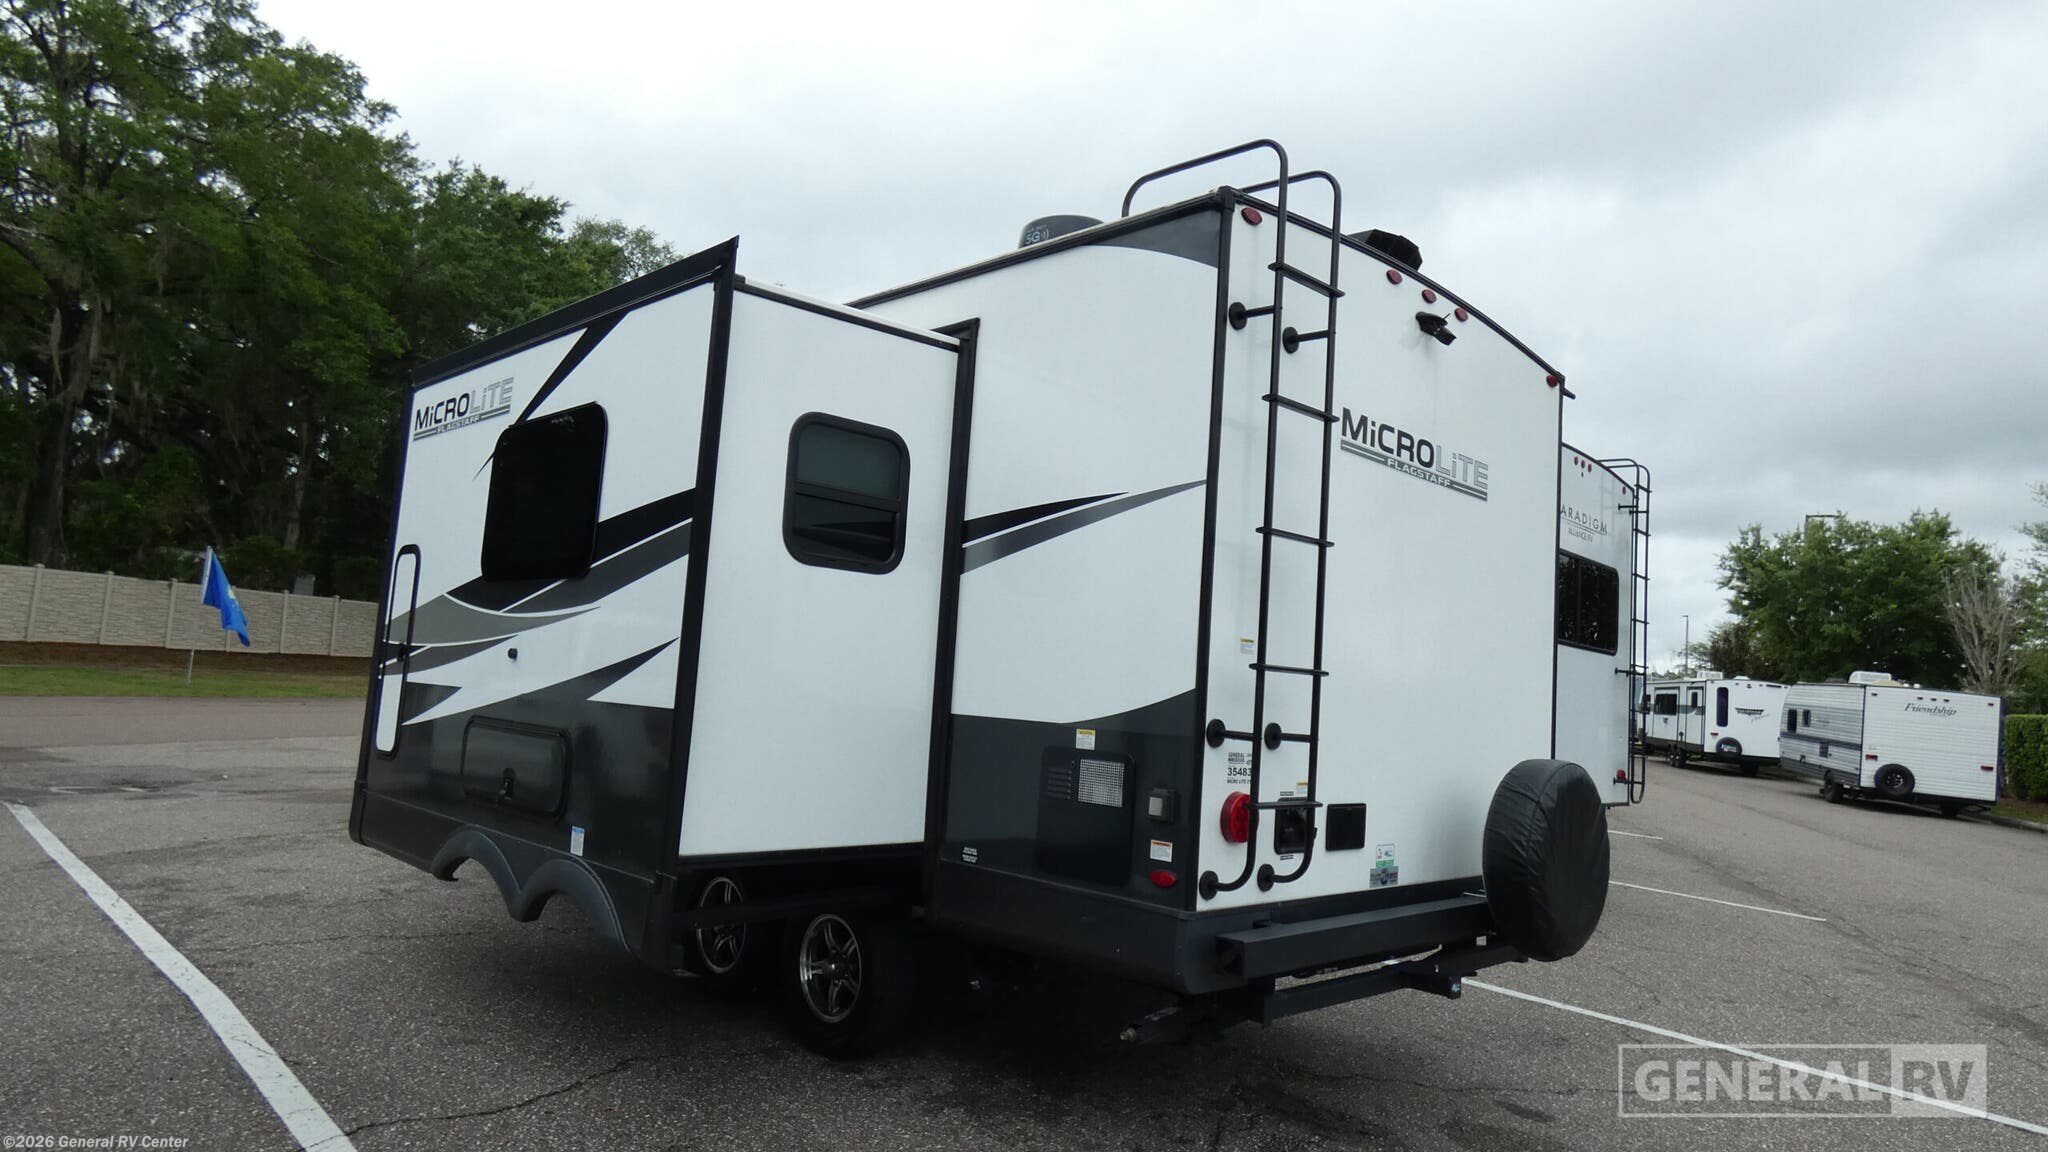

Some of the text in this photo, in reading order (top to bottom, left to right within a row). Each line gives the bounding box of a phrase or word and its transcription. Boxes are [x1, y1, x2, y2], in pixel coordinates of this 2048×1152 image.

[1387, 458, 1451, 487] FLAGSTAFF
[1560, 504, 1608, 535] ARADIGM
[1904, 703, 1957, 716] Friendship
